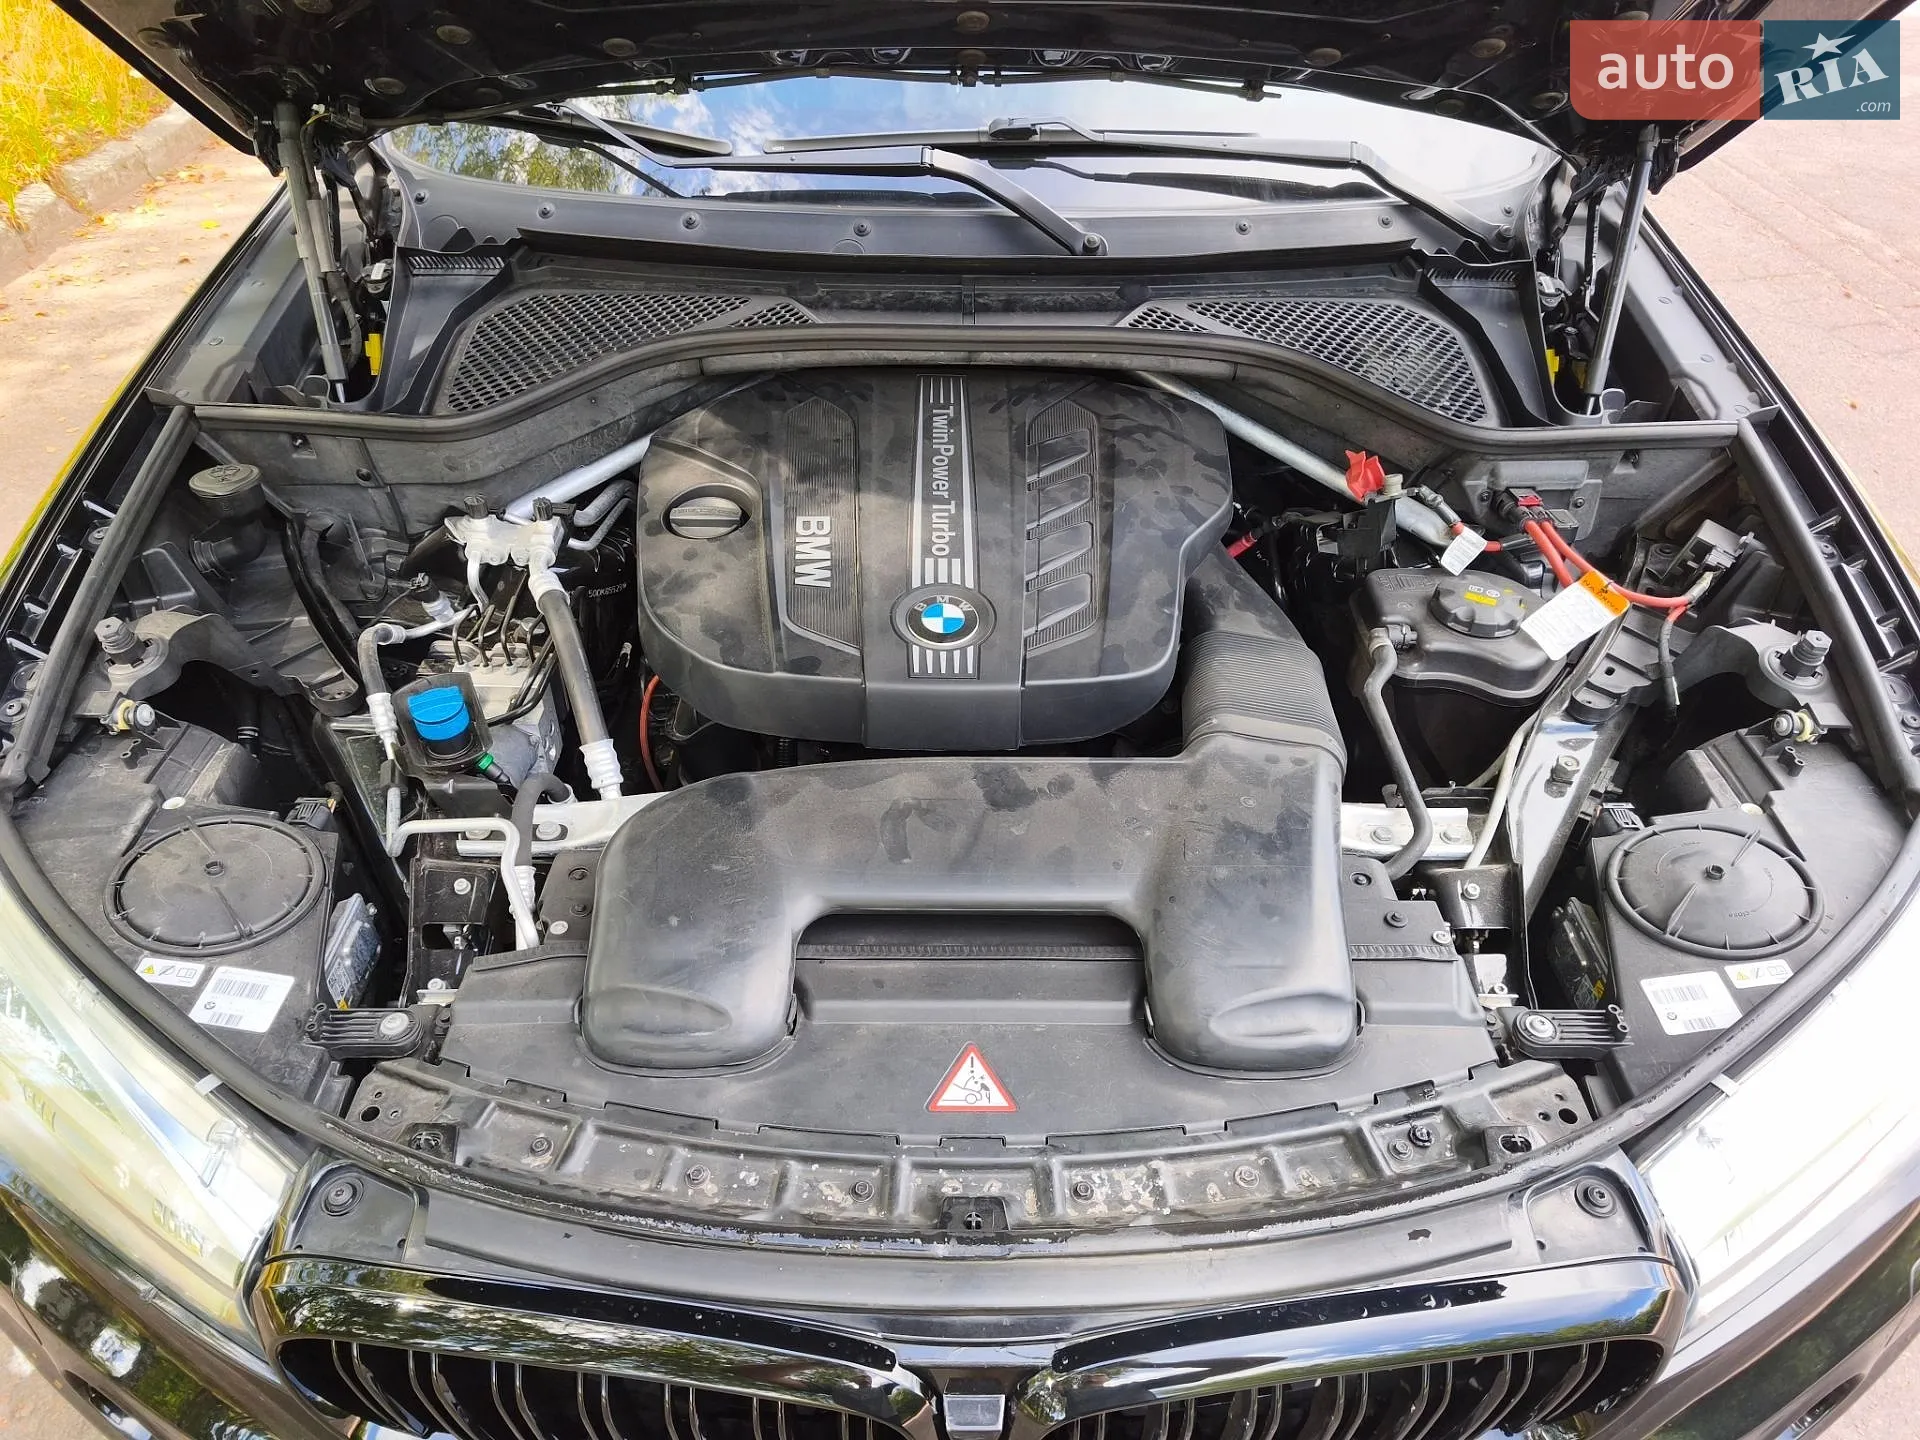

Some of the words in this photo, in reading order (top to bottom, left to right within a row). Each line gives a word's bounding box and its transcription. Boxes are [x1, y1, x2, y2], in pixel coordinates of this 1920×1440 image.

[931, 406, 955, 498] TwinPower
[795, 516, 832, 587] BMW
[931, 501, 955, 556] Turbo
